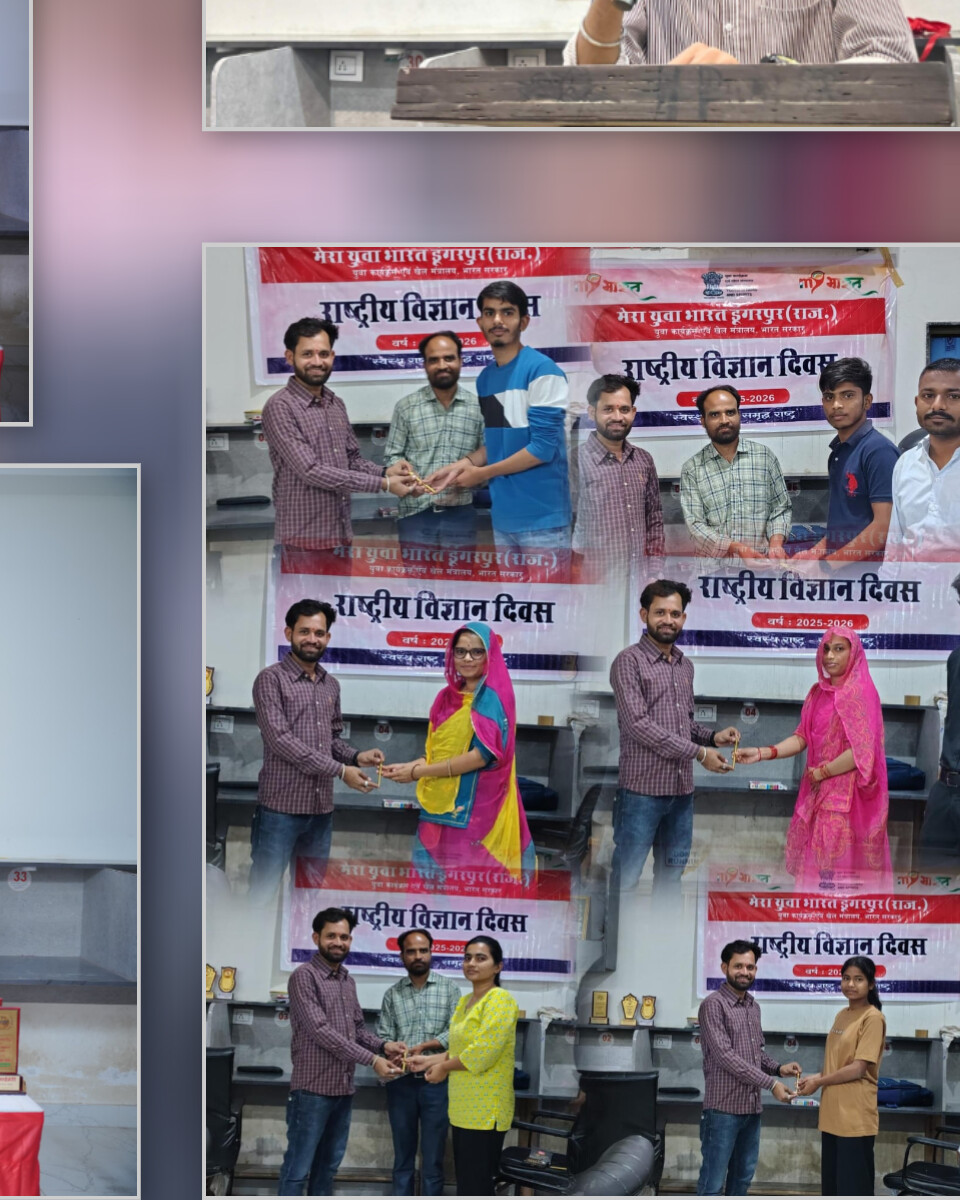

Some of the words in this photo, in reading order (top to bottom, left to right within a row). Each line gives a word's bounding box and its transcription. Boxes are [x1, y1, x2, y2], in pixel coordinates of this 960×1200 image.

[383, 247, 428, 263] भारत
[401, 291, 477, 322] विज्ञान
[617, 308, 645, 324] मेरा
[650, 310, 681, 327] युवा
[685, 309, 727, 322] भारत
[622, 351, 698, 385] राष्ट्रीय
[701, 350, 775, 380] विज्ञान
[698, 569, 776, 605] राष्ट्रीय
[779, 571, 854, 601] विज्ञान
[858, 573, 921, 603] दिवस
[334, 589, 410, 623] राष्ट्रीय
[414, 590, 490, 621] विज्ञान
[492, 593, 556, 623] दिवस
[767, 616, 784, 627] वर्ष
[796, 618, 854, 628] 2025-2026
[402, 635, 421, 645] वर्ष
[13, 870, 27, 882] 33
[749, 896, 772, 909] मेरा
[775, 897, 800, 912] युवा
[803, 897, 837, 910] भारत
[410, 903, 472, 931] विज्ञान
[475, 907, 528, 933] दिवस
[814, 932, 875, 956] विज्ञान
[877, 932, 927, 956] दिवस
